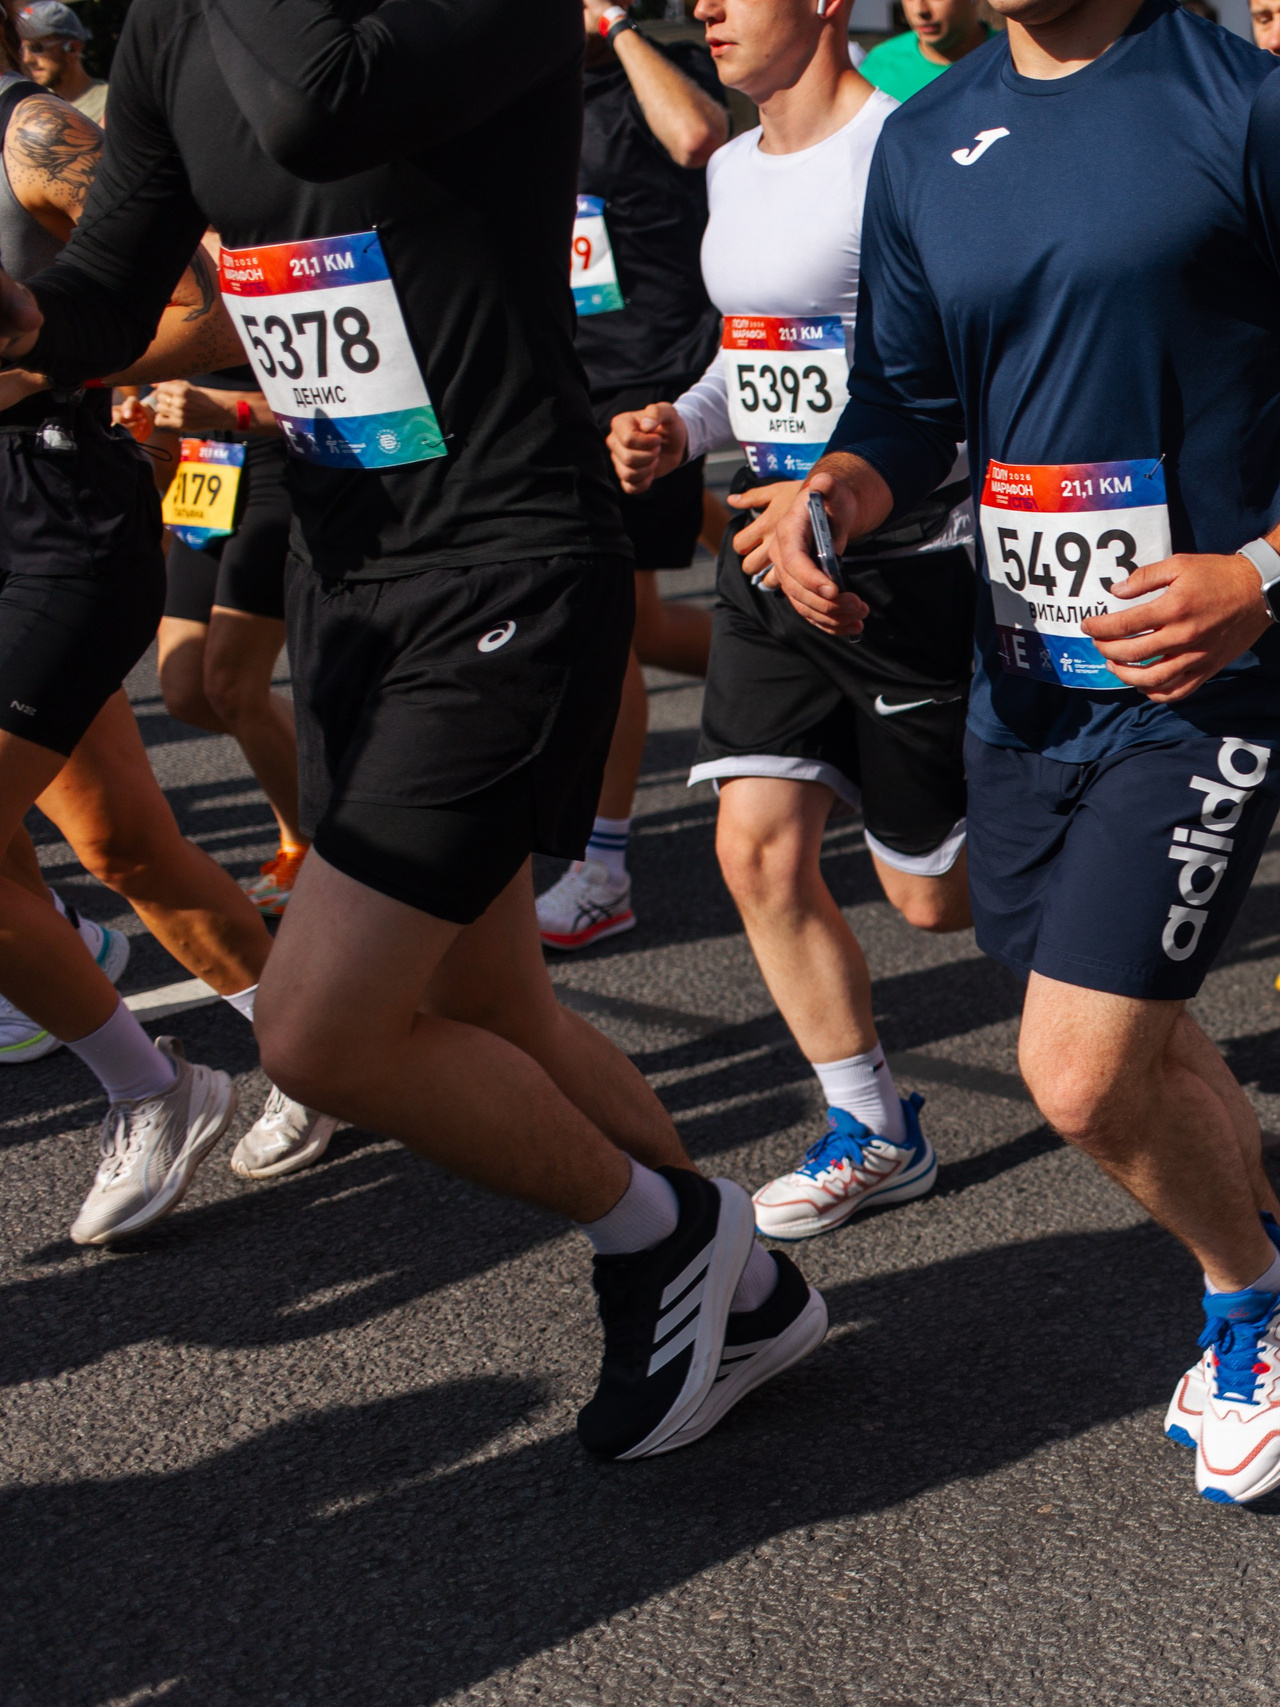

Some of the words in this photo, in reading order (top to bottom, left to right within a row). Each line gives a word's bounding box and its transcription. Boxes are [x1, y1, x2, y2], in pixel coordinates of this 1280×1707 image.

[289, 258, 321, 277] 21,1
[241, 306, 380, 380] 5378
[778, 327, 798, 342] 21,1
[292, 385, 347, 409] ДЕНИС
[737, 364, 833, 413] 5393
[769, 416, 807, 433] АРТЁМ
[1008, 472, 1032, 481] 2026
[991, 480, 1034, 497] МАРАФОН
[1060, 479, 1094, 499] 21,1
[997, 526, 1139, 598] 5493
[1028, 601, 1109, 624] ВИТАЛИЙ
